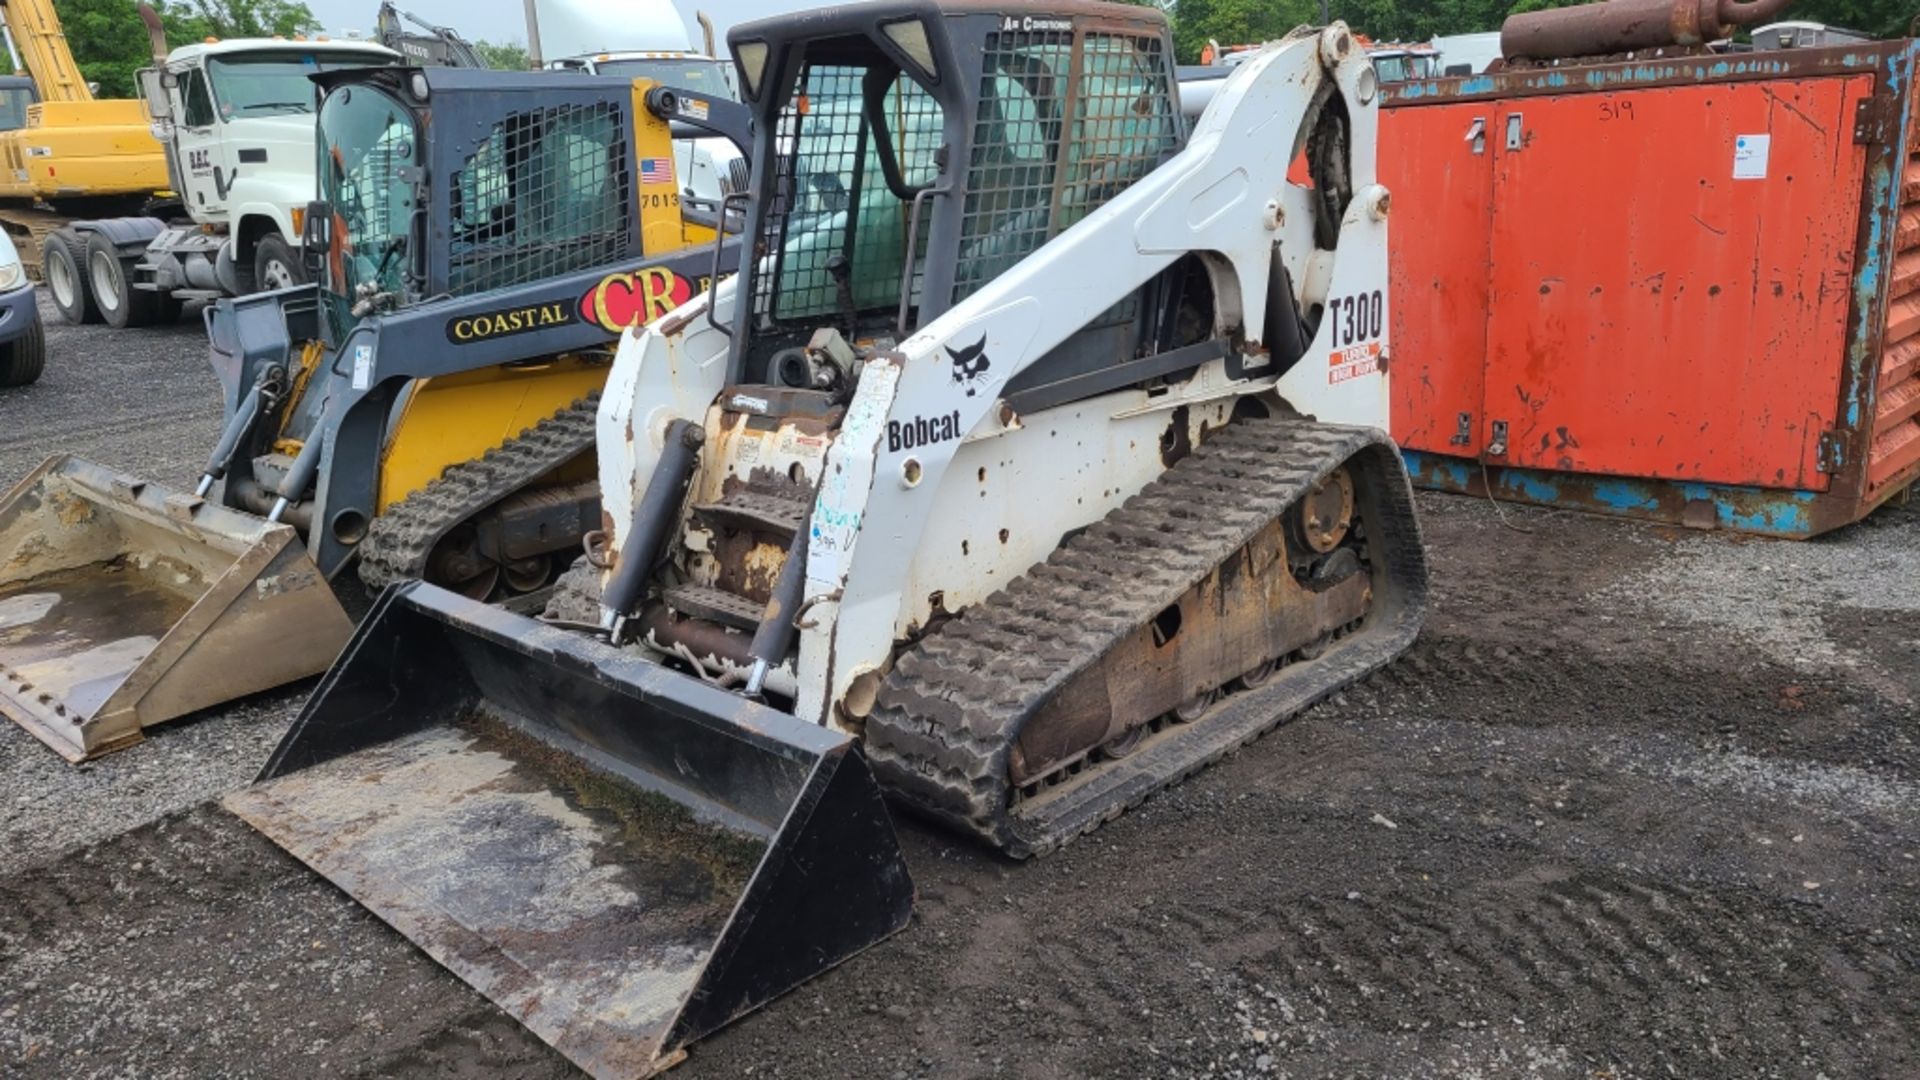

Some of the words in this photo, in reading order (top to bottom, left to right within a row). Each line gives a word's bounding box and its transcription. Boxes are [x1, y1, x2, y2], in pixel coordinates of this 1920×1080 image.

[1598, 100, 1635, 121] 319
[641, 194, 680, 209] 7013
[454, 303, 569, 340] COASTAL
[594, 265, 677, 334] CR
[1329, 289, 1383, 349] T300
[888, 409, 961, 453] Bobcat
